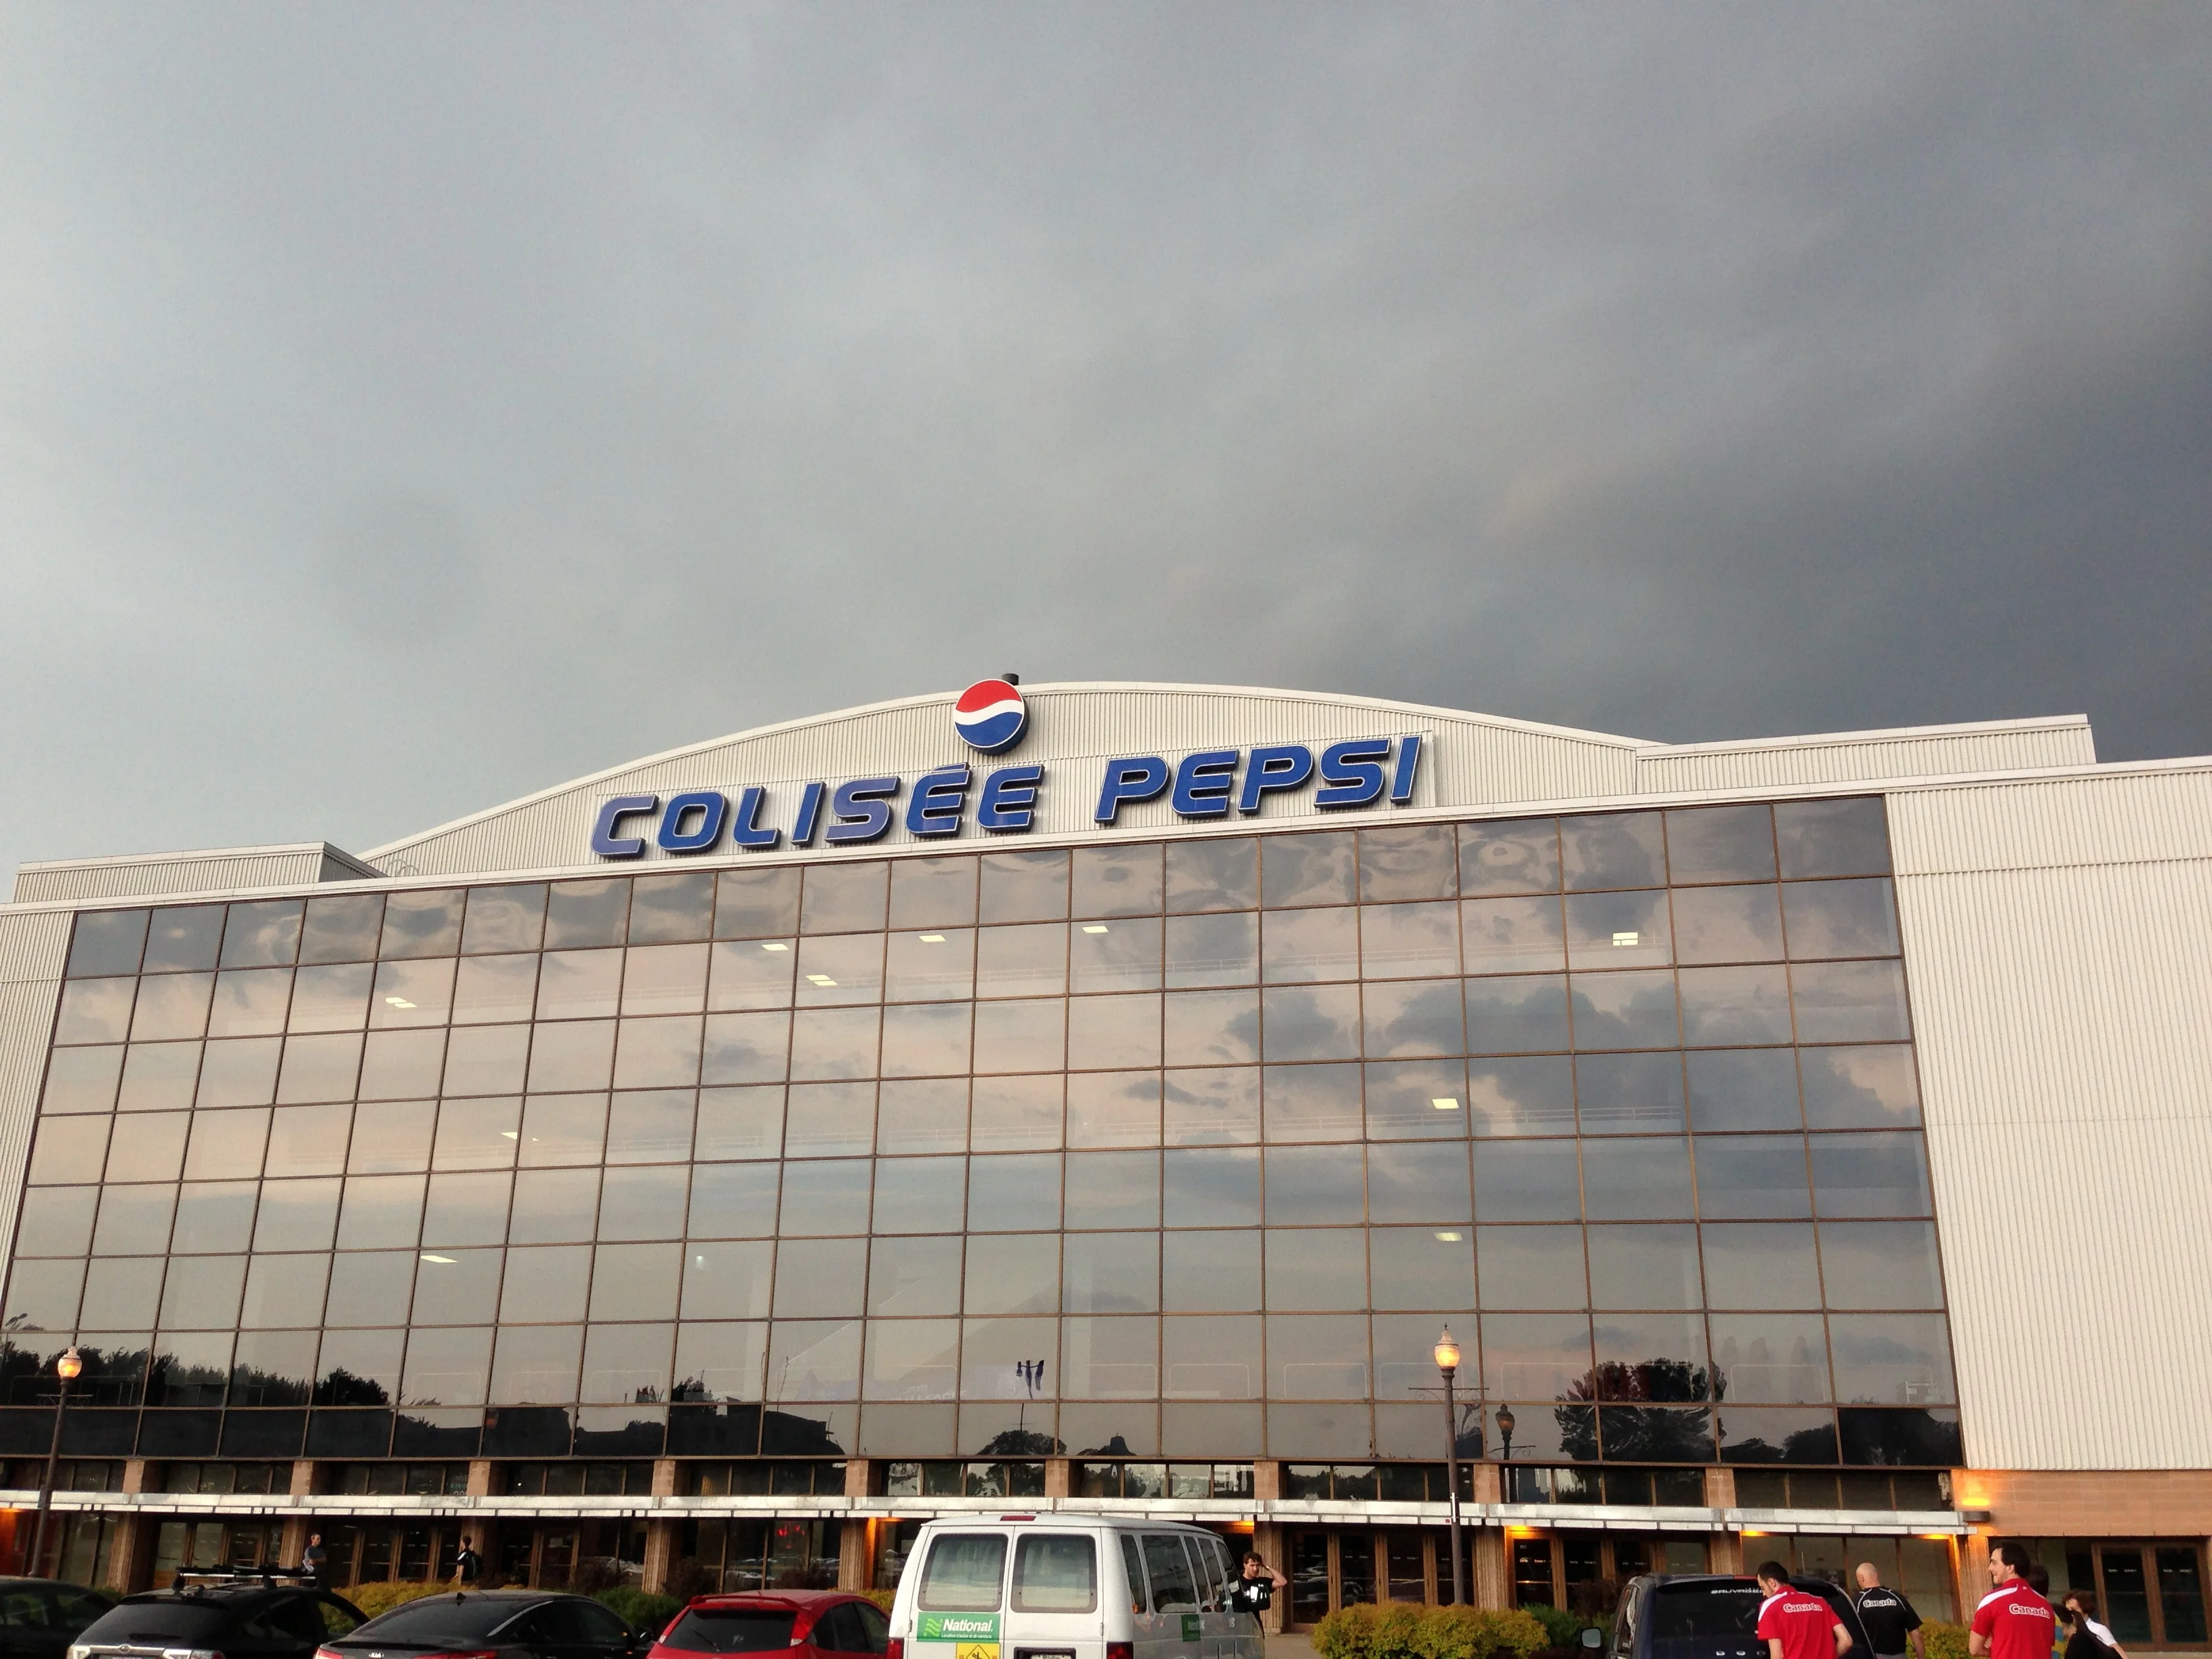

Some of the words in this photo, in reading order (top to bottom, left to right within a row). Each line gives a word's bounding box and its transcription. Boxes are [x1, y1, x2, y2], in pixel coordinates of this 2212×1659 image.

[592, 762, 1045, 859] COLISÉE
[1094, 735, 1422, 824] PEPSI
[1783, 1603, 1823, 1613] Canada
[1864, 1598, 1897, 1607] Canada
[2009, 1603, 2050, 1619] Canada
